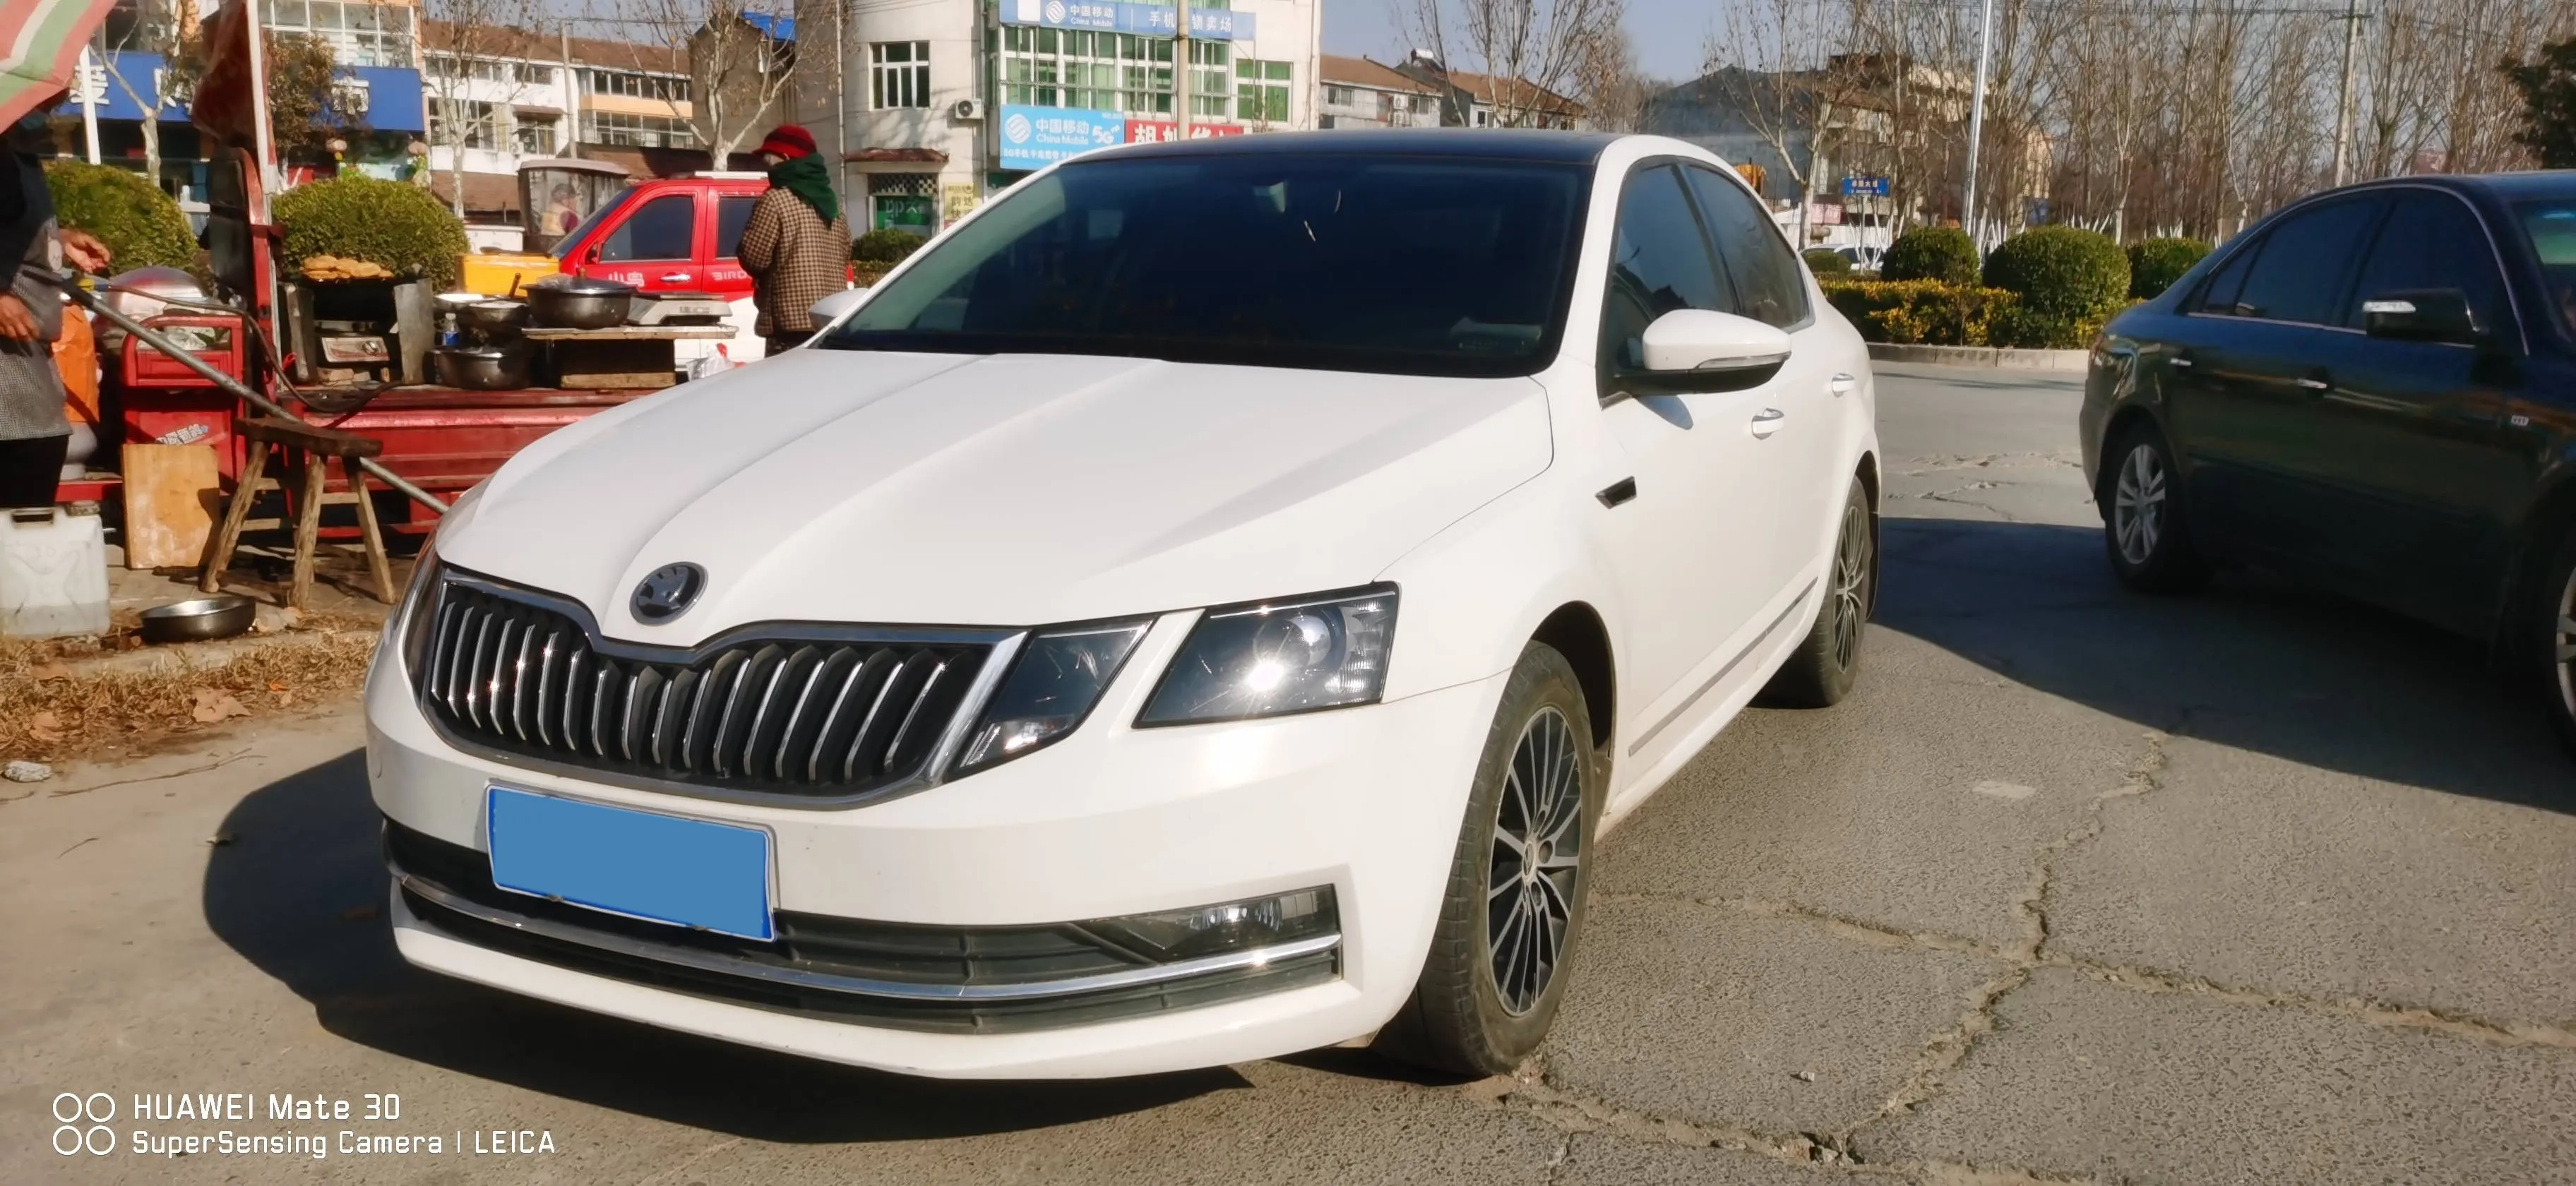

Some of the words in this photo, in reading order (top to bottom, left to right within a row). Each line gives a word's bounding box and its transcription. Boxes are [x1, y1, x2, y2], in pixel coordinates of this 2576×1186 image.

[1071, 4, 1113, 18] 中国移动
[1036, 119, 1089, 134] 中国移动
[1036, 133, 1059, 144] China
[1061, 136, 1088, 145] Mobile
